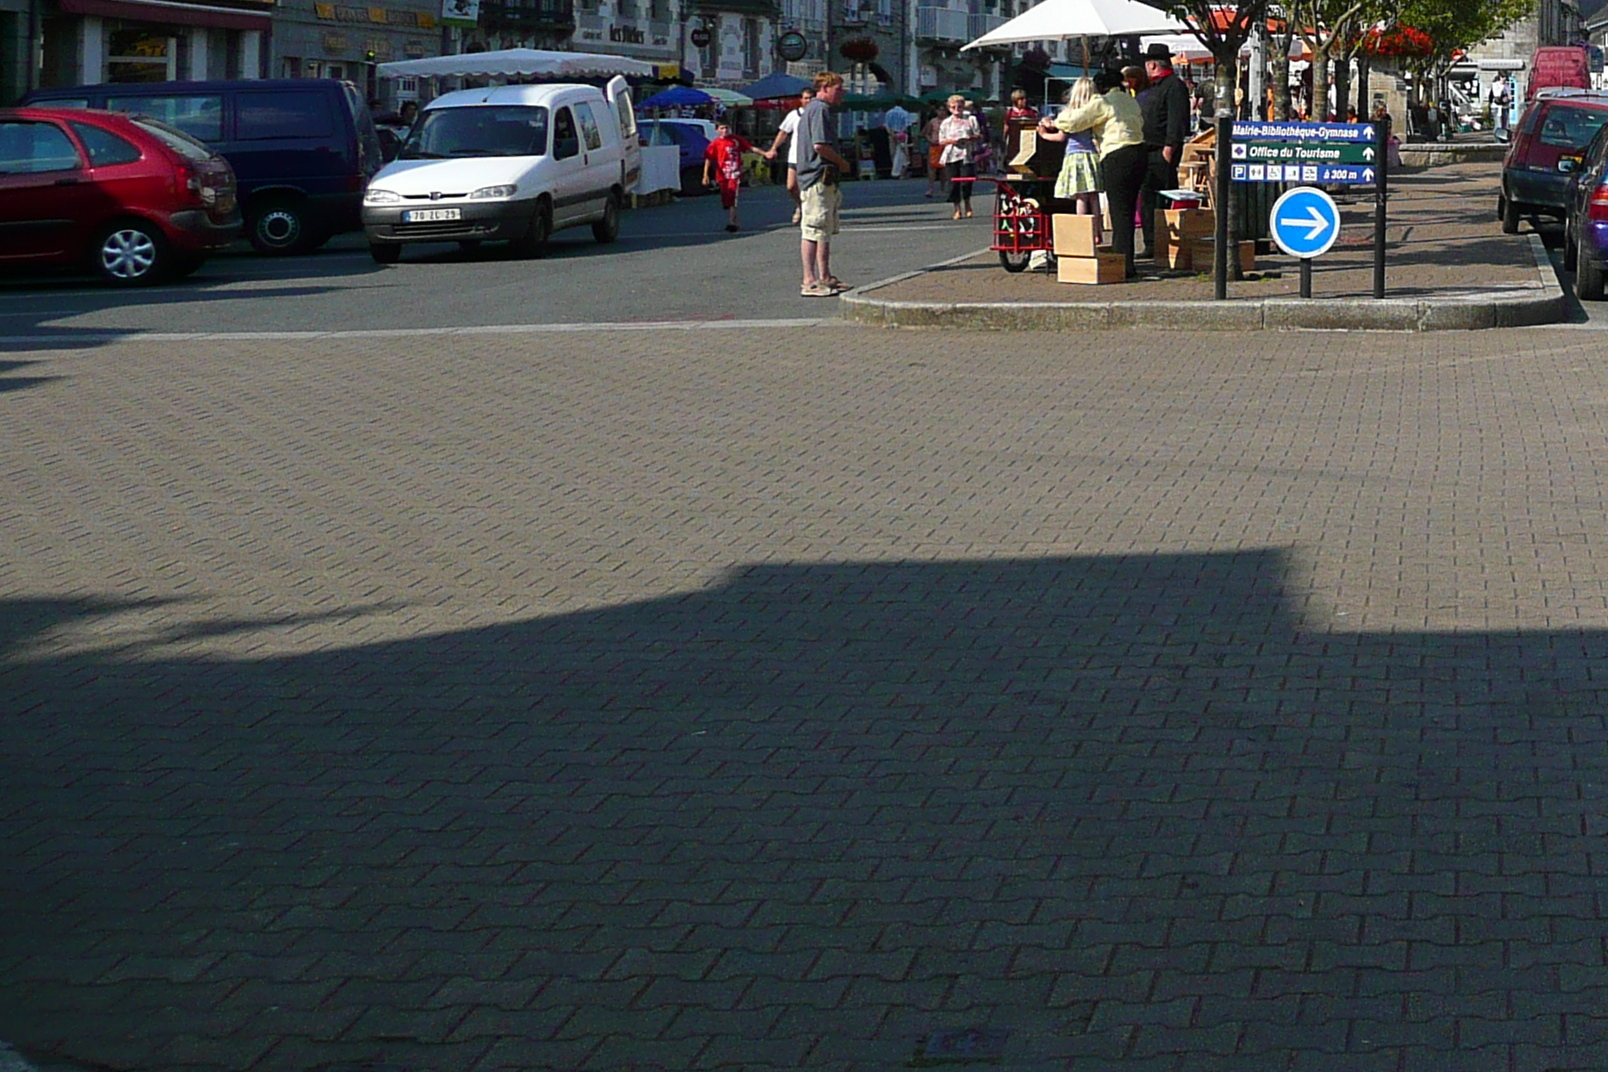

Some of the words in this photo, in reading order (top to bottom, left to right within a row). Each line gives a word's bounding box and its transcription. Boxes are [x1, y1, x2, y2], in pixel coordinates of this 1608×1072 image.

[1249, 146, 1279, 158] Office
[1280, 147, 1293, 158] du
[1295, 147, 1340, 159] Tourisme
[1331, 169, 1348, 179] 300
[1348, 171, 1357, 179] m
